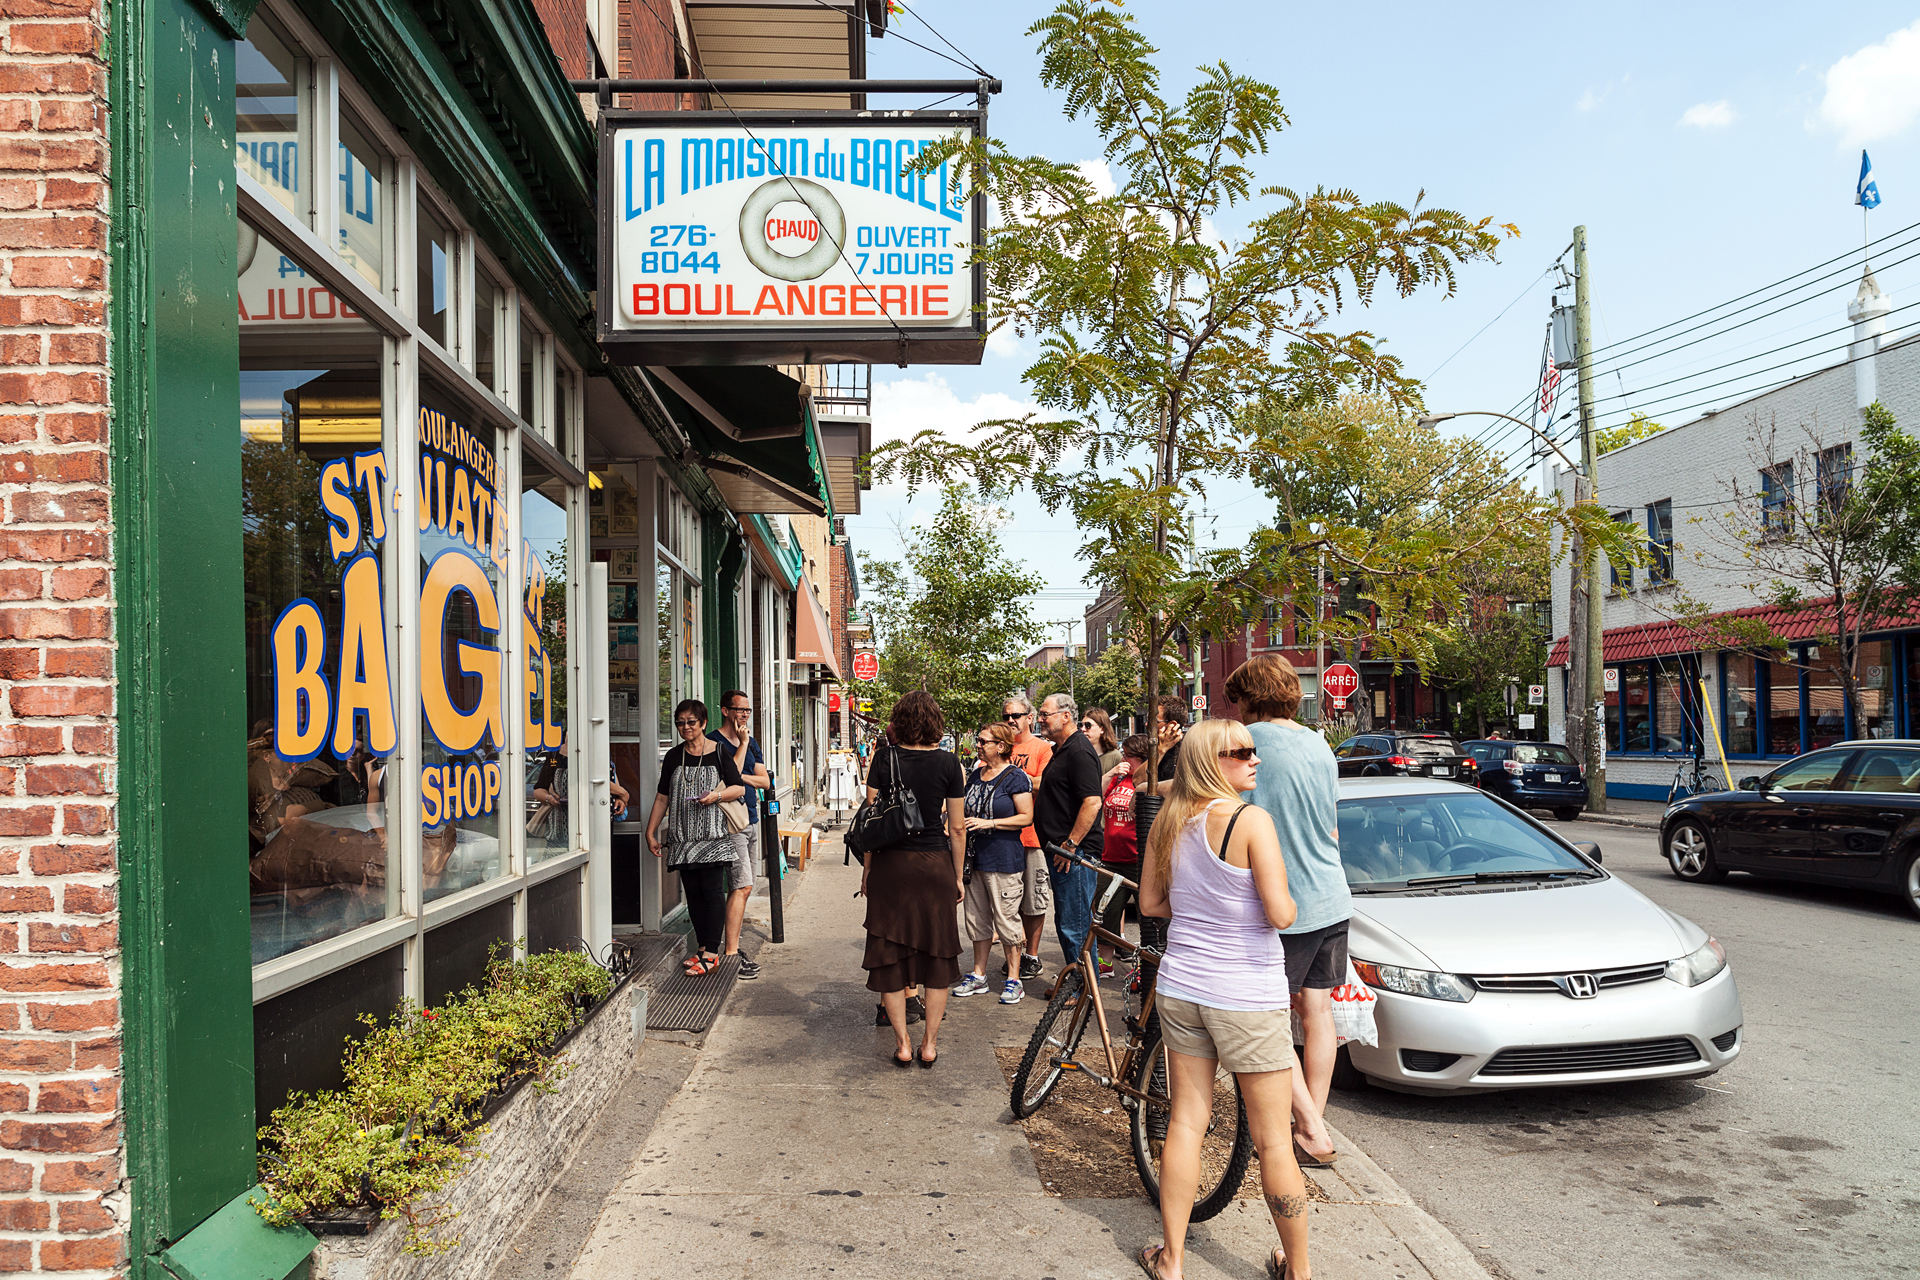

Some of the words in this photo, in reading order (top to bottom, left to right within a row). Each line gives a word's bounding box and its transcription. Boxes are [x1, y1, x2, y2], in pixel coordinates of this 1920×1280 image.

[625, 138, 665, 222] LA
[681, 138, 809, 196] MAISON
[814, 138, 846, 182] du
[650, 224, 717, 248] 276-
[766, 217, 820, 243] CHAUD
[856, 226, 952, 249] OUVERT
[641, 251, 721, 275] 8044
[855, 253, 870, 275] 7
[872, 253, 954, 276] JOURS
[633, 283, 949, 316] BOULANGERIE
[417, 404, 507, 500] OULANGERIE
[270, 548, 563, 764] BAGEL
[1324, 674, 1357, 687] ARRÊT
[421, 760, 502, 829] SHOP
